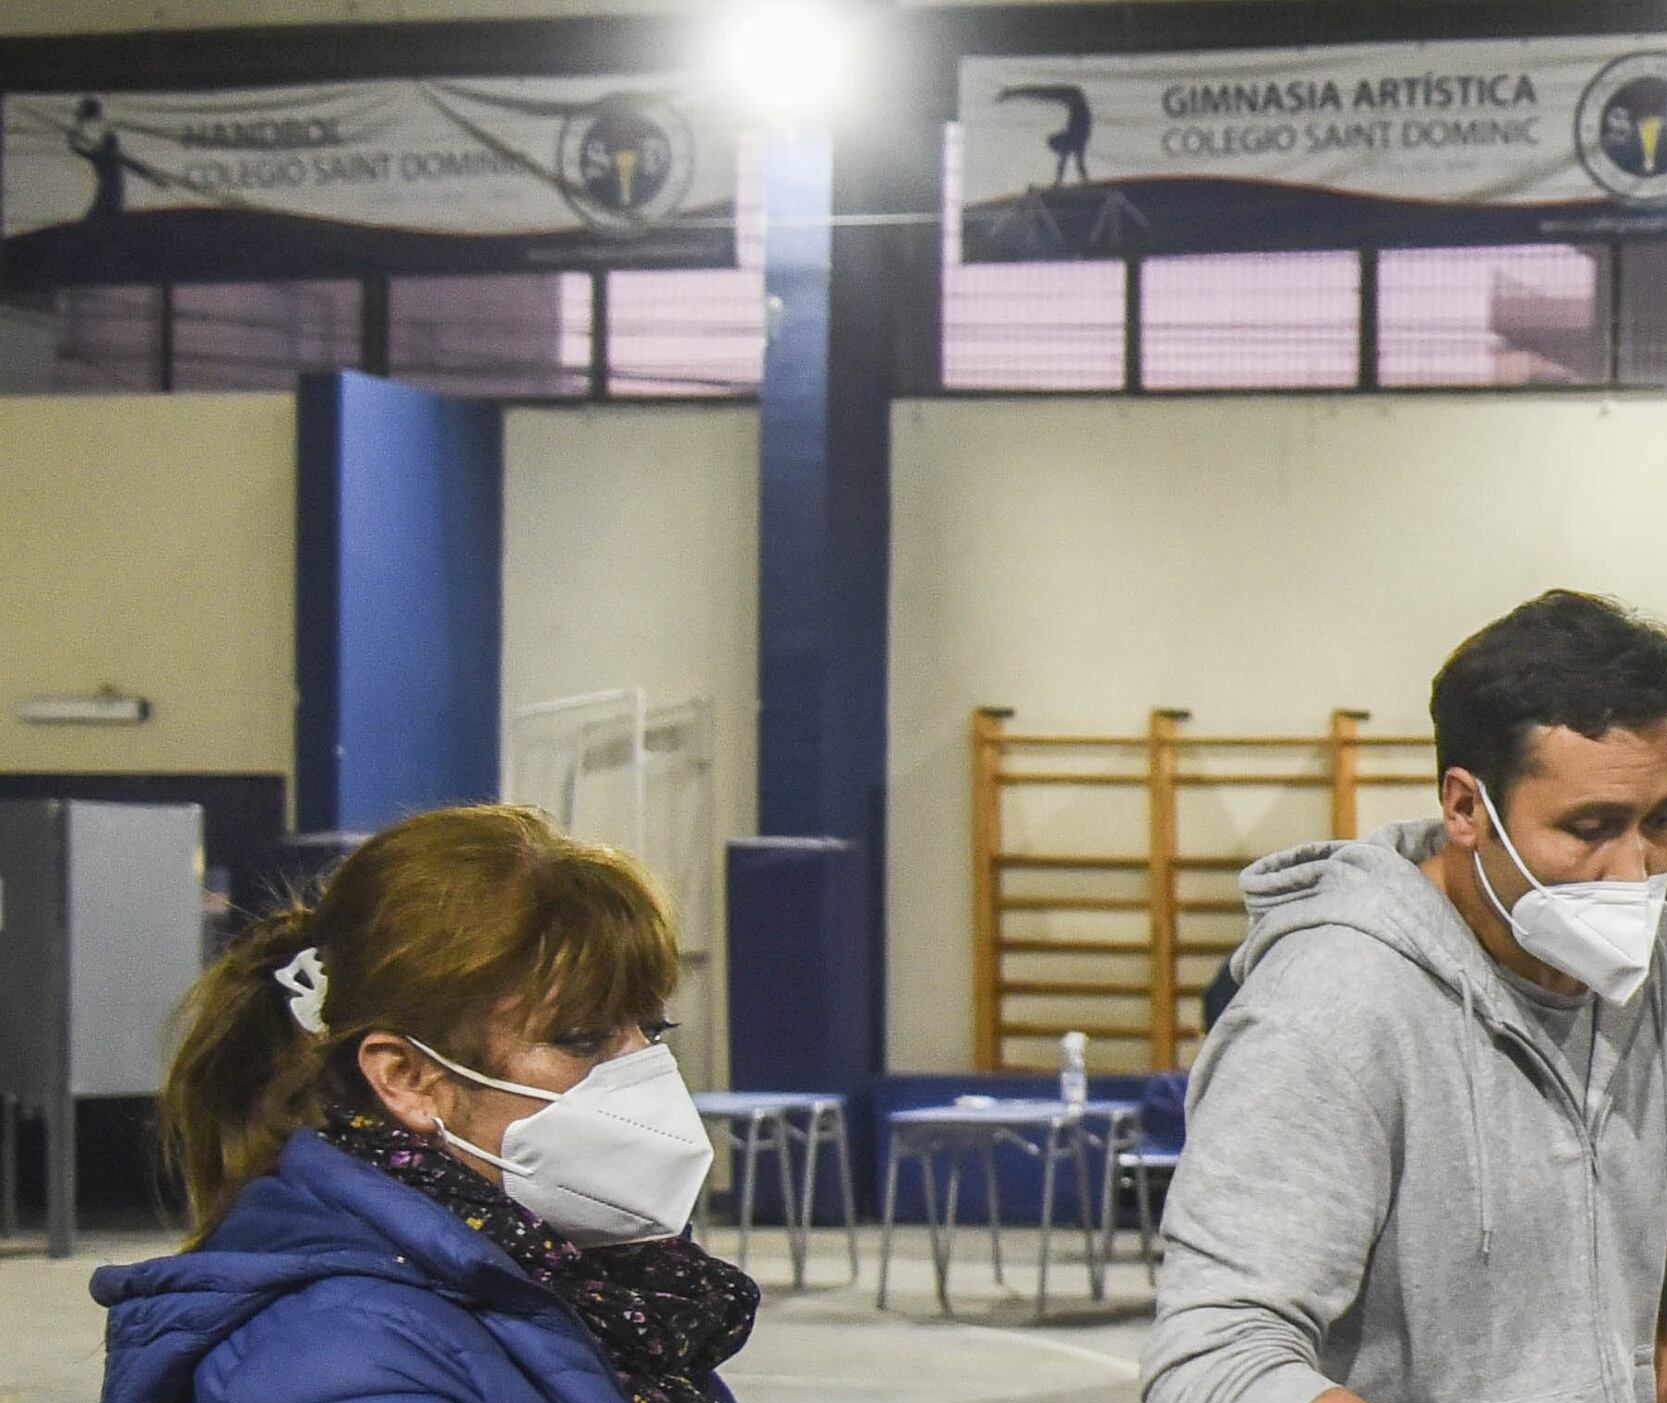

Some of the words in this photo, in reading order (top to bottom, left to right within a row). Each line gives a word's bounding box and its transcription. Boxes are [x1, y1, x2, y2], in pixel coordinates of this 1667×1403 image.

[1163, 80, 1345, 119] GIMNASIA
[1354, 71, 1537, 110] ARTÍSTICA
[1161, 121, 1299, 157] COLEGIO
[1304, 119, 1392, 153] SAINT
[1402, 115, 1540, 149] DOMINIC
[186, 158, 308, 188] COLEGIO
[312, 152, 393, 184] SAINT
